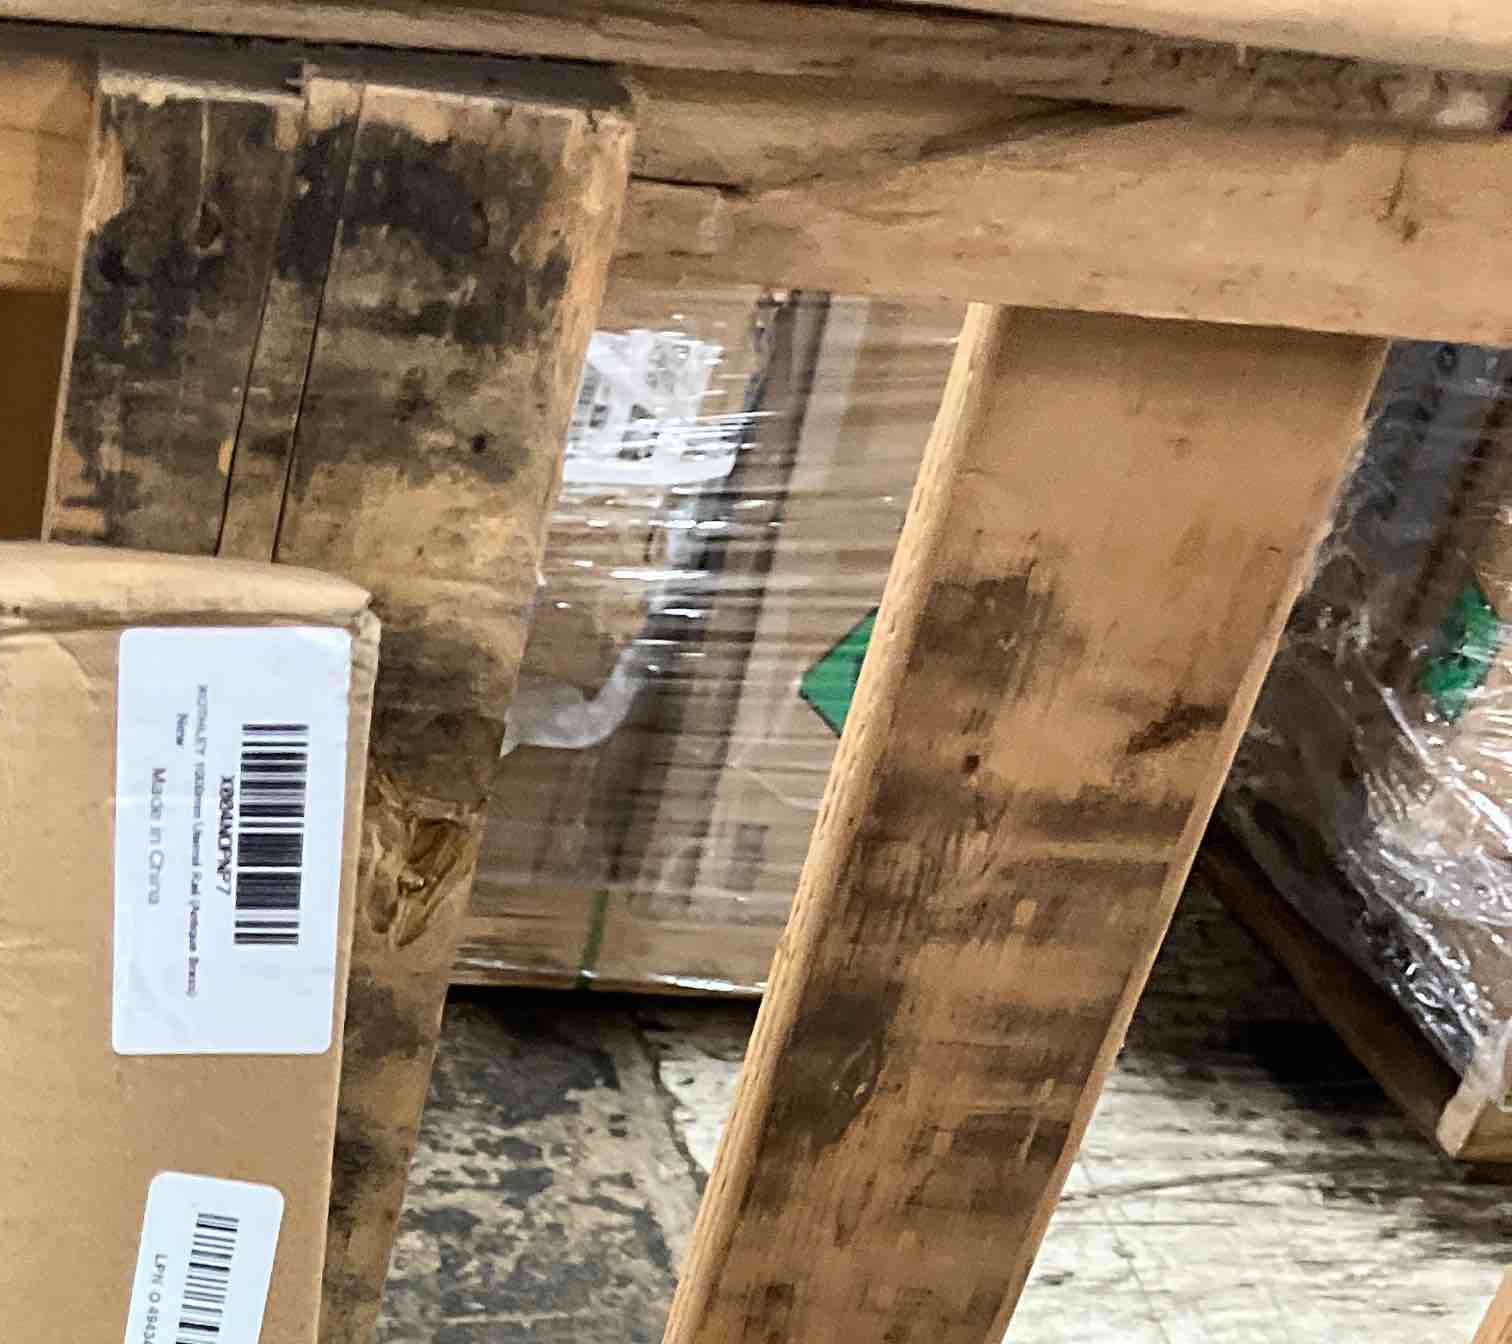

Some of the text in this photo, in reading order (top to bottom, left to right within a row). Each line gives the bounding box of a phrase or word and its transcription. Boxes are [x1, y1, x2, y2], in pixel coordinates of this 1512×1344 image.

[176, 713, 189, 747] New
[147, 767, 168, 905] Made in China
[151, 1253, 169, 1286] LPN
